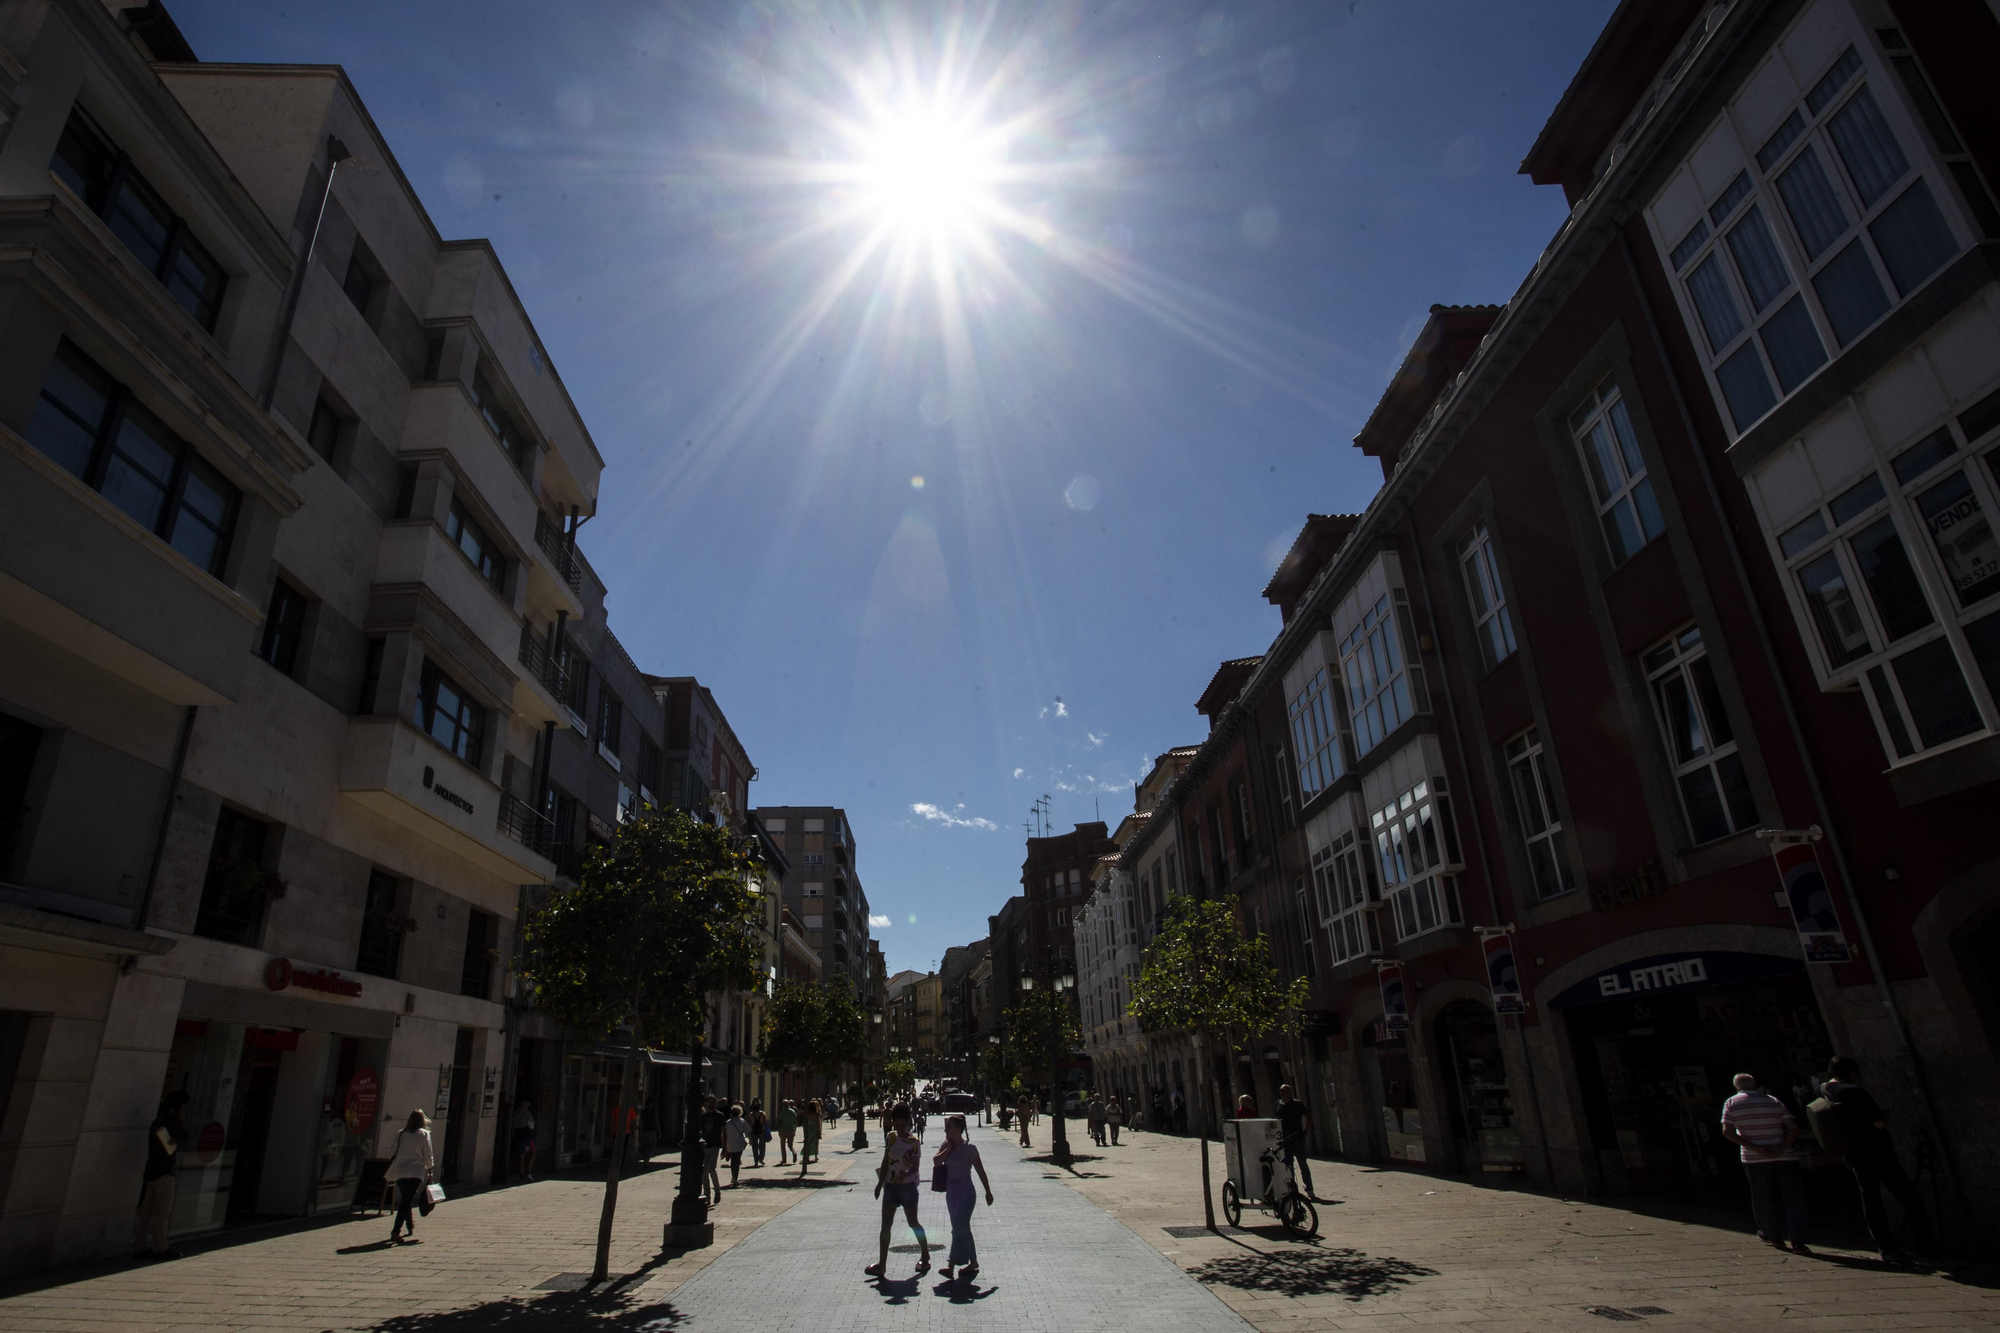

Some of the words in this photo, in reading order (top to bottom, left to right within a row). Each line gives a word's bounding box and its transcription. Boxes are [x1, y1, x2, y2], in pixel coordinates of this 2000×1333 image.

[1928, 495, 1982, 535] VENDE
[1955, 573, 1974, 589] 985
[1974, 567, 1987, 580] 52
[1986, 560, 1998, 573] 17
[1925, 709, 1979, 739] asesoría
[433, 783, 474, 815] ARQUITECTOS
[292, 969, 363, 998] vodafone
[1598, 974, 1632, 997] EL
[1629, 957, 1708, 992] ATRIO
[1276, 1130, 1283, 1141] 3
